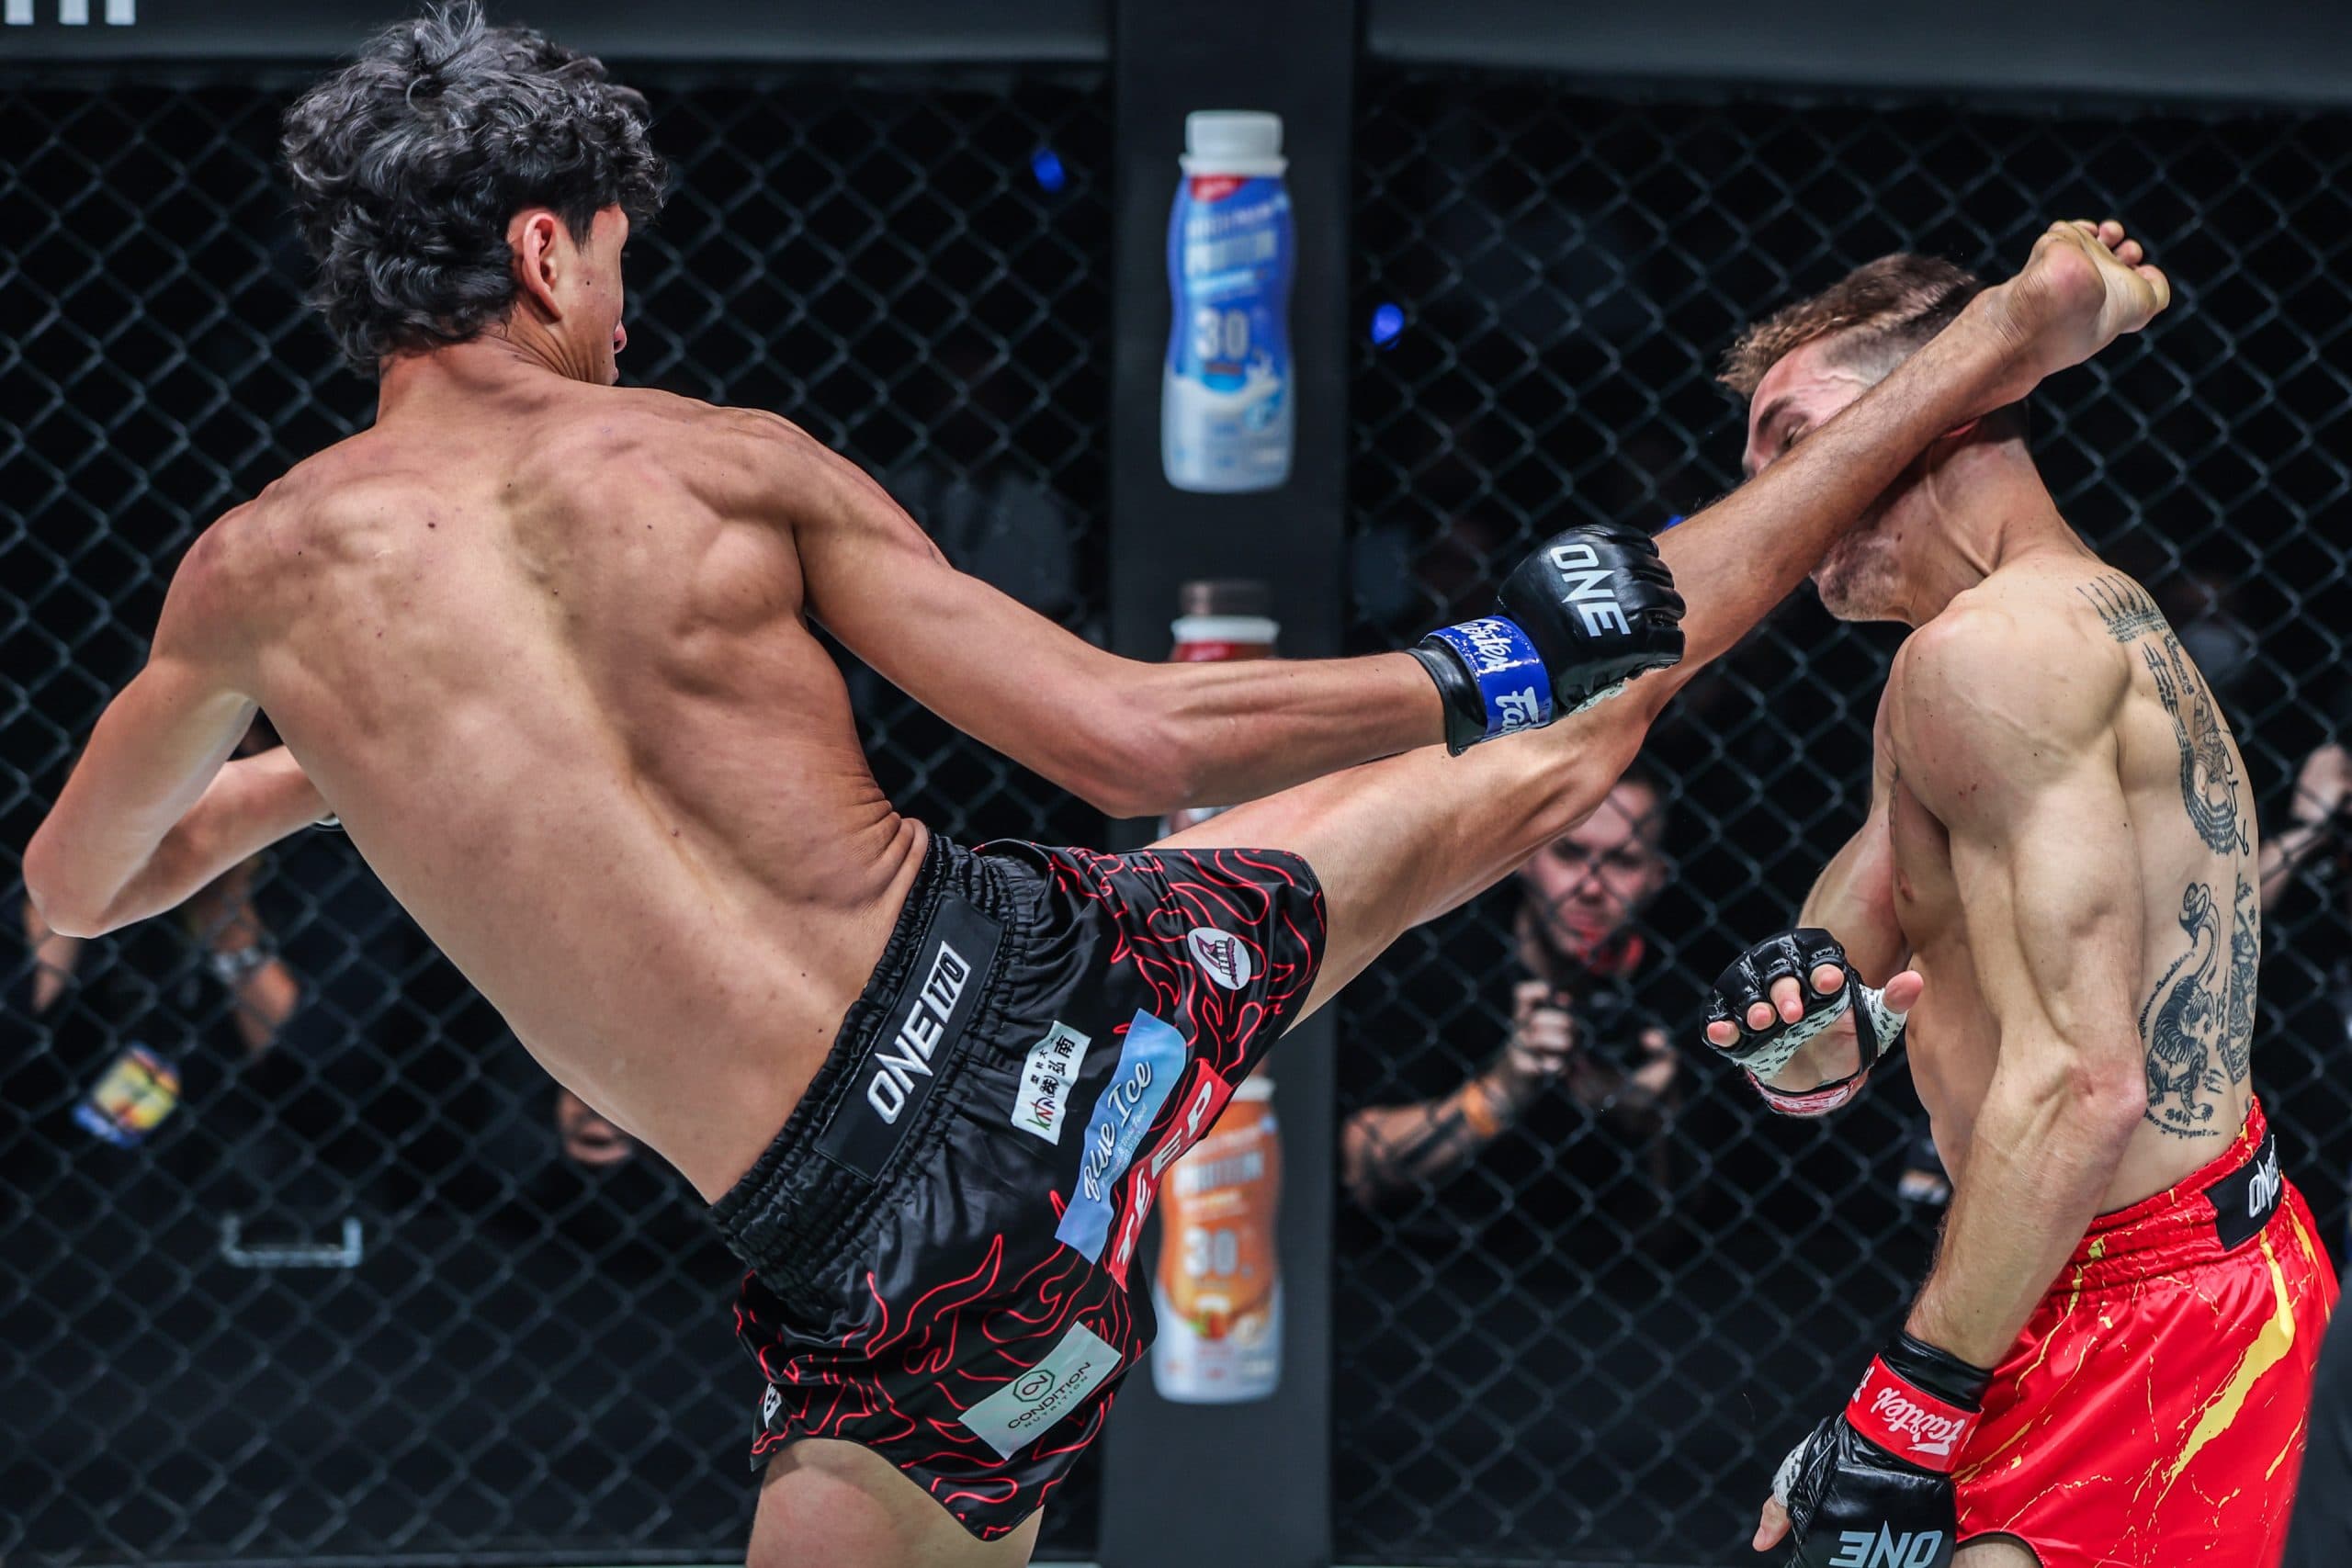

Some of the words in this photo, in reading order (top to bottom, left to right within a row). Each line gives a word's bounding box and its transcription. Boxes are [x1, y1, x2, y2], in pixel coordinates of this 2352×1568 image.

[1194, 307, 1249, 360] 30
[1550, 543, 1632, 637] ONE
[866, 998, 944, 1125] ONE
[926, 950, 965, 1010] 170
[1083, 1121, 1116, 1202] Blue
[1107, 1060, 1153, 1130] Ice
[1182, 1226, 1238, 1280] 30
[1007, 1361, 1091, 1429] CONDITION
[1870, 1387, 1966, 1455] Fairtex
[1828, 1520, 1943, 1568] ONE
